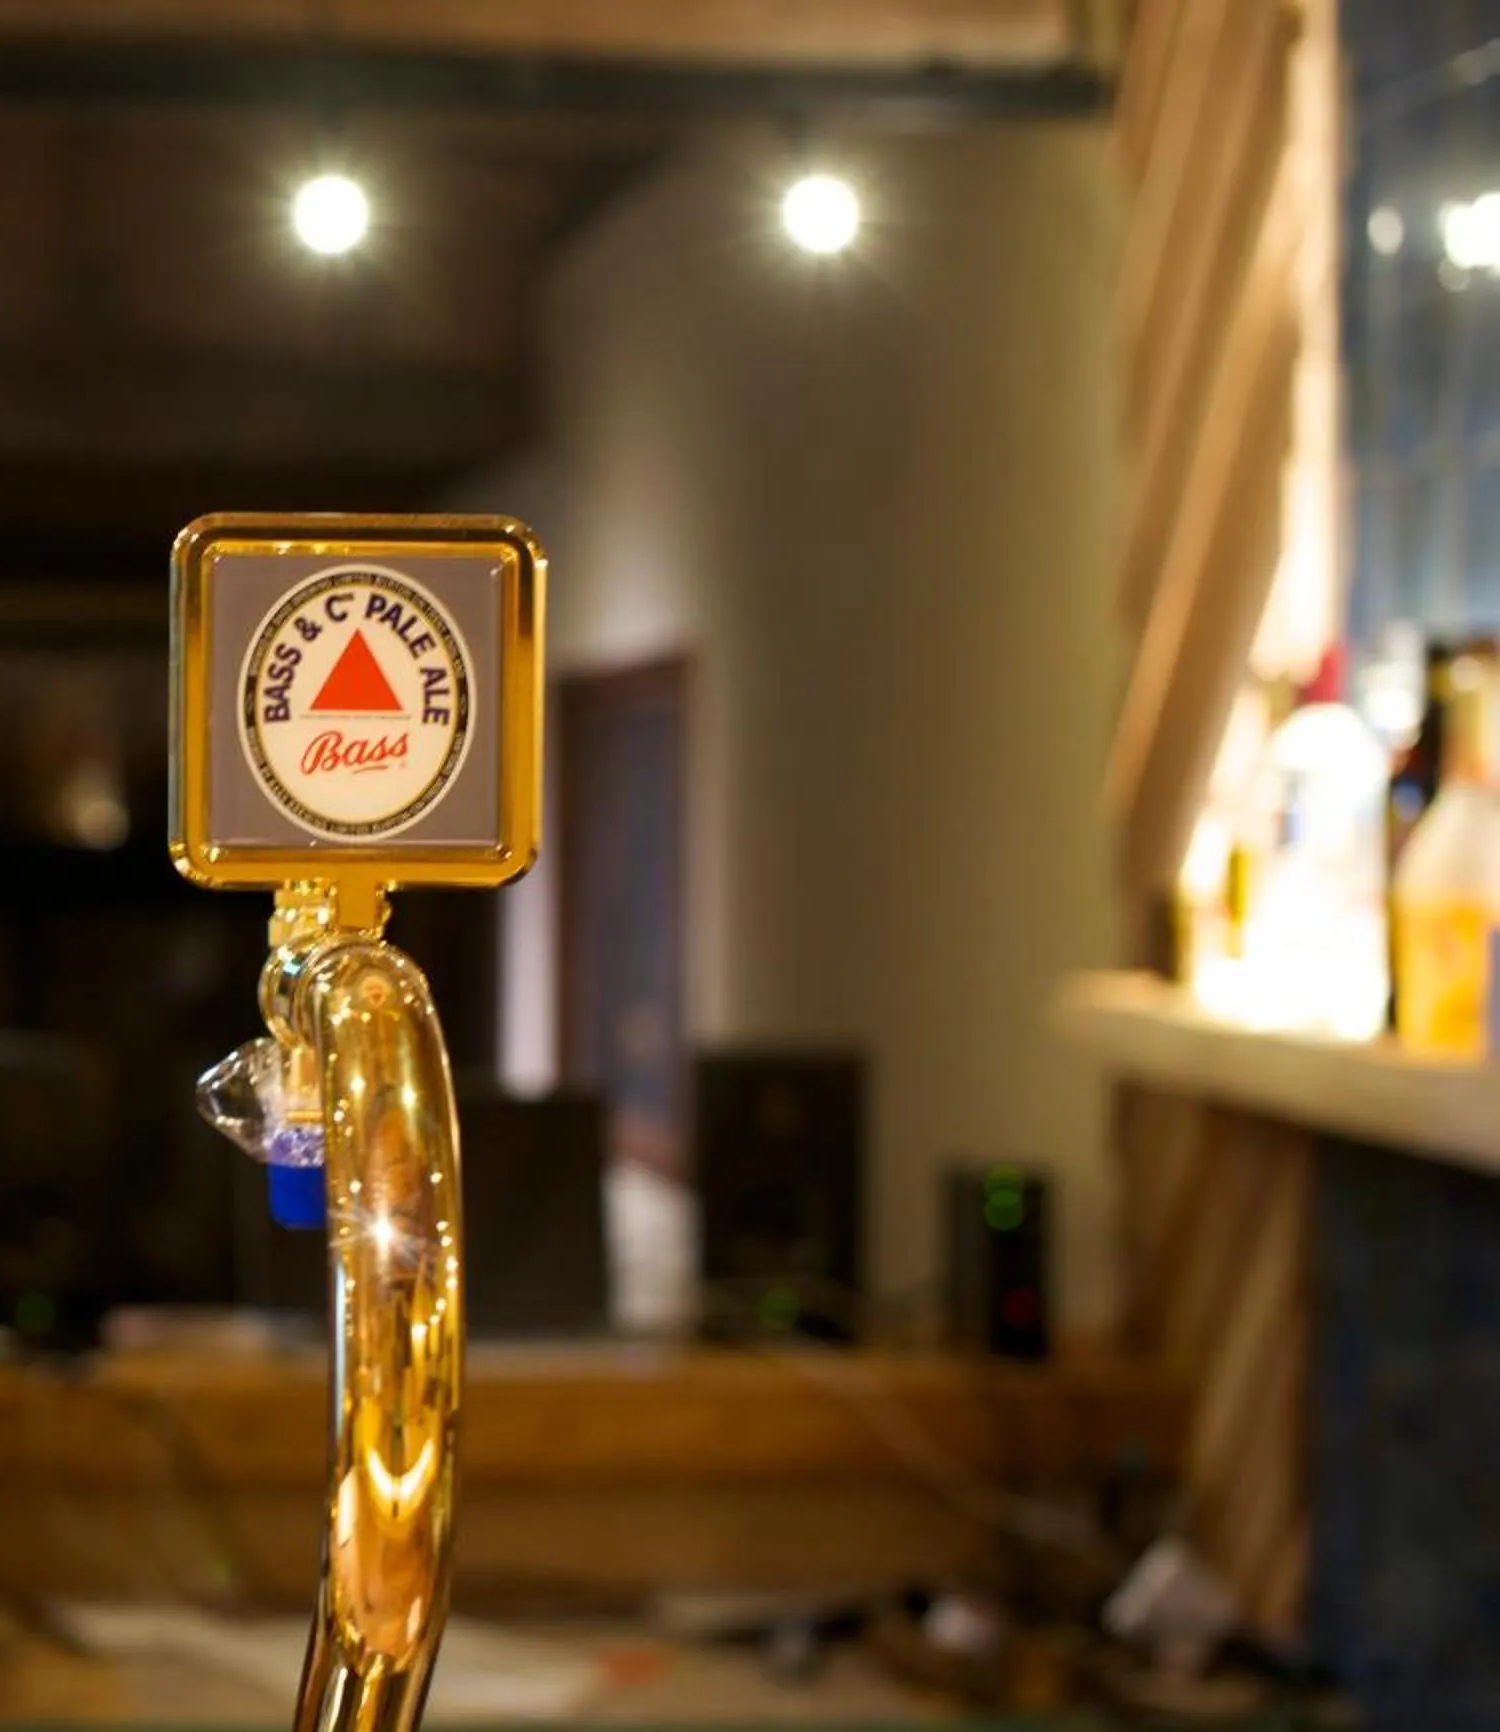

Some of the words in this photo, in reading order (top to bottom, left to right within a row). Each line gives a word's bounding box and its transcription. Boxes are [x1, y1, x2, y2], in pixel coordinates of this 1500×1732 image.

[263, 643, 302, 724] BASS
[294, 617, 323, 642] &
[364, 593, 437, 661] PALE
[419, 665, 452, 726] ALE
[300, 730, 409, 774] Bass
